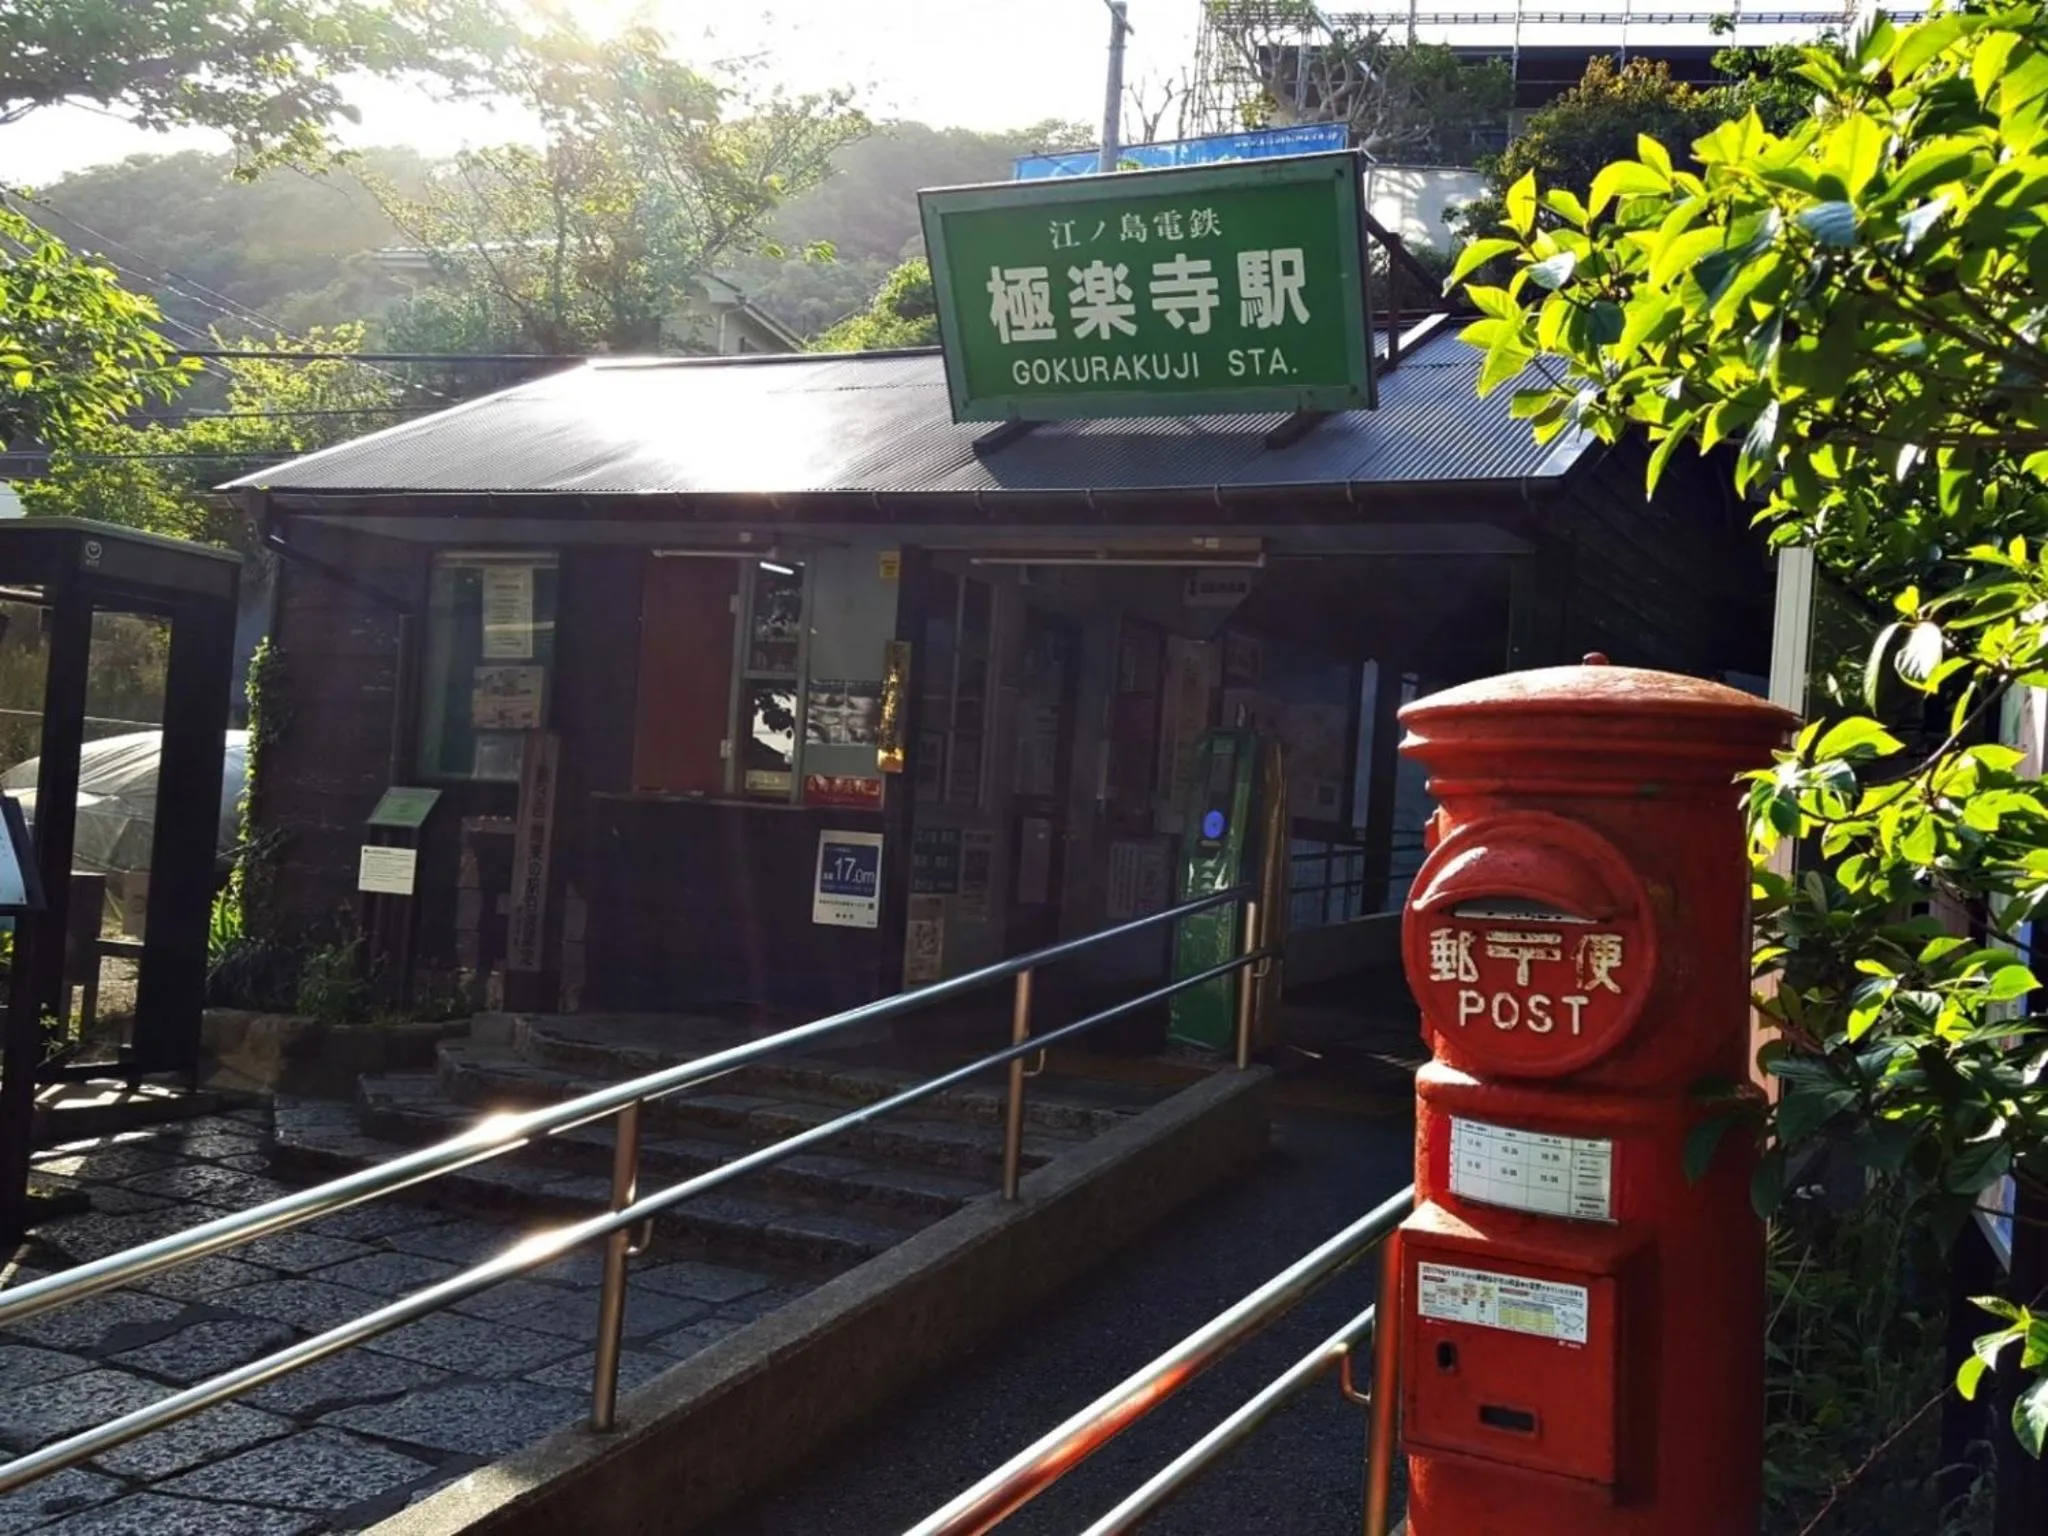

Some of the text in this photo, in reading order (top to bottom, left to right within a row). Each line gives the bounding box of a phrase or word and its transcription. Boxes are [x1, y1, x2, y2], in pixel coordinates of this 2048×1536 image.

[1049, 208, 1223, 250] 江ノ島電鉄
[986, 247, 1310, 345] 極楽寺駅
[1012, 348, 1299, 386] GOKURAKUJI STA.
[1458, 989, 1589, 1036] POST
